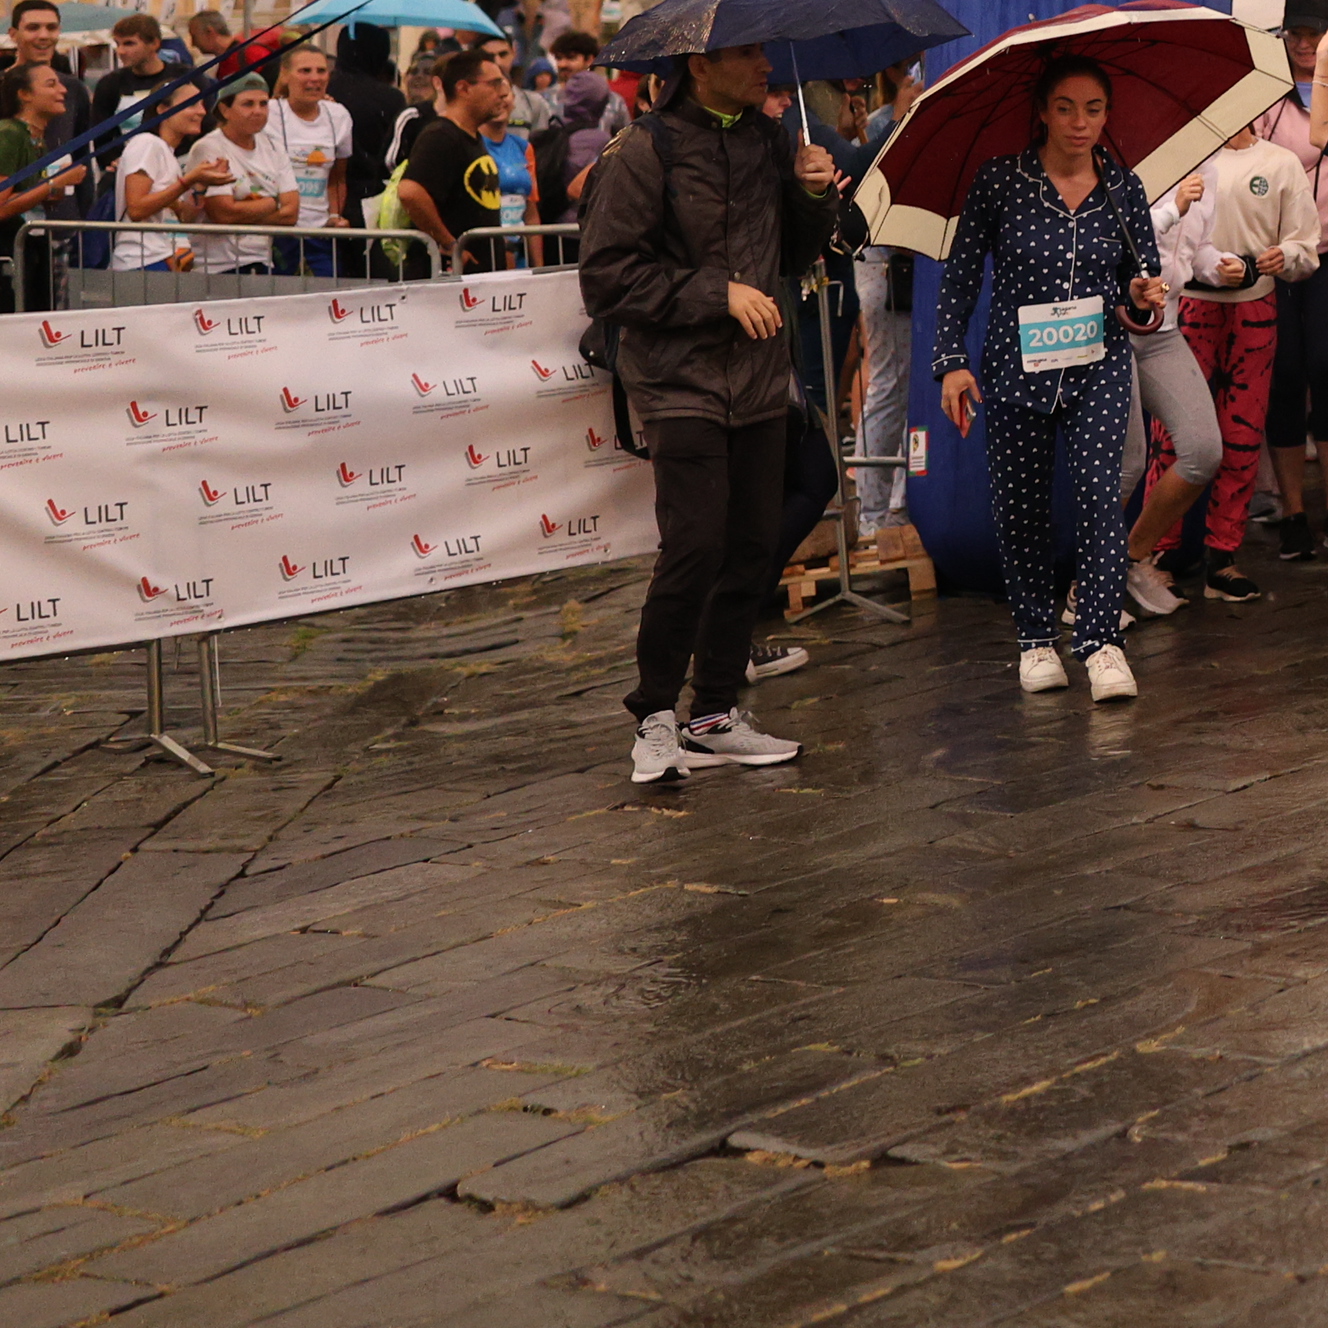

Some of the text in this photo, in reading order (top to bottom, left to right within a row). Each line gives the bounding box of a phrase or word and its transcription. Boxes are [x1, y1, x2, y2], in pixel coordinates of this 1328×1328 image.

[359, 303, 397, 324] LILT
[491, 292, 528, 313] LILT
[226, 315, 266, 336] LILT
[1028, 320, 1098, 347] 20020
[80, 326, 126, 349] LILT
[442, 376, 478, 397] LILT
[314, 390, 352, 413] LILT
[165, 405, 209, 428] LILT
[4, 420, 51, 444] LILT
[614, 431, 645, 451] LT
[496, 446, 531, 469] LILT
[368, 463, 407, 487] LILT
[233, 482, 272, 506] LILT
[83, 501, 129, 526] LILT
[567, 514, 601, 537] LILT
[444, 535, 482, 558] LILT
[312, 555, 350, 580] LILT
[174, 577, 214, 602] LILT
[16, 597, 61, 623] LILT
